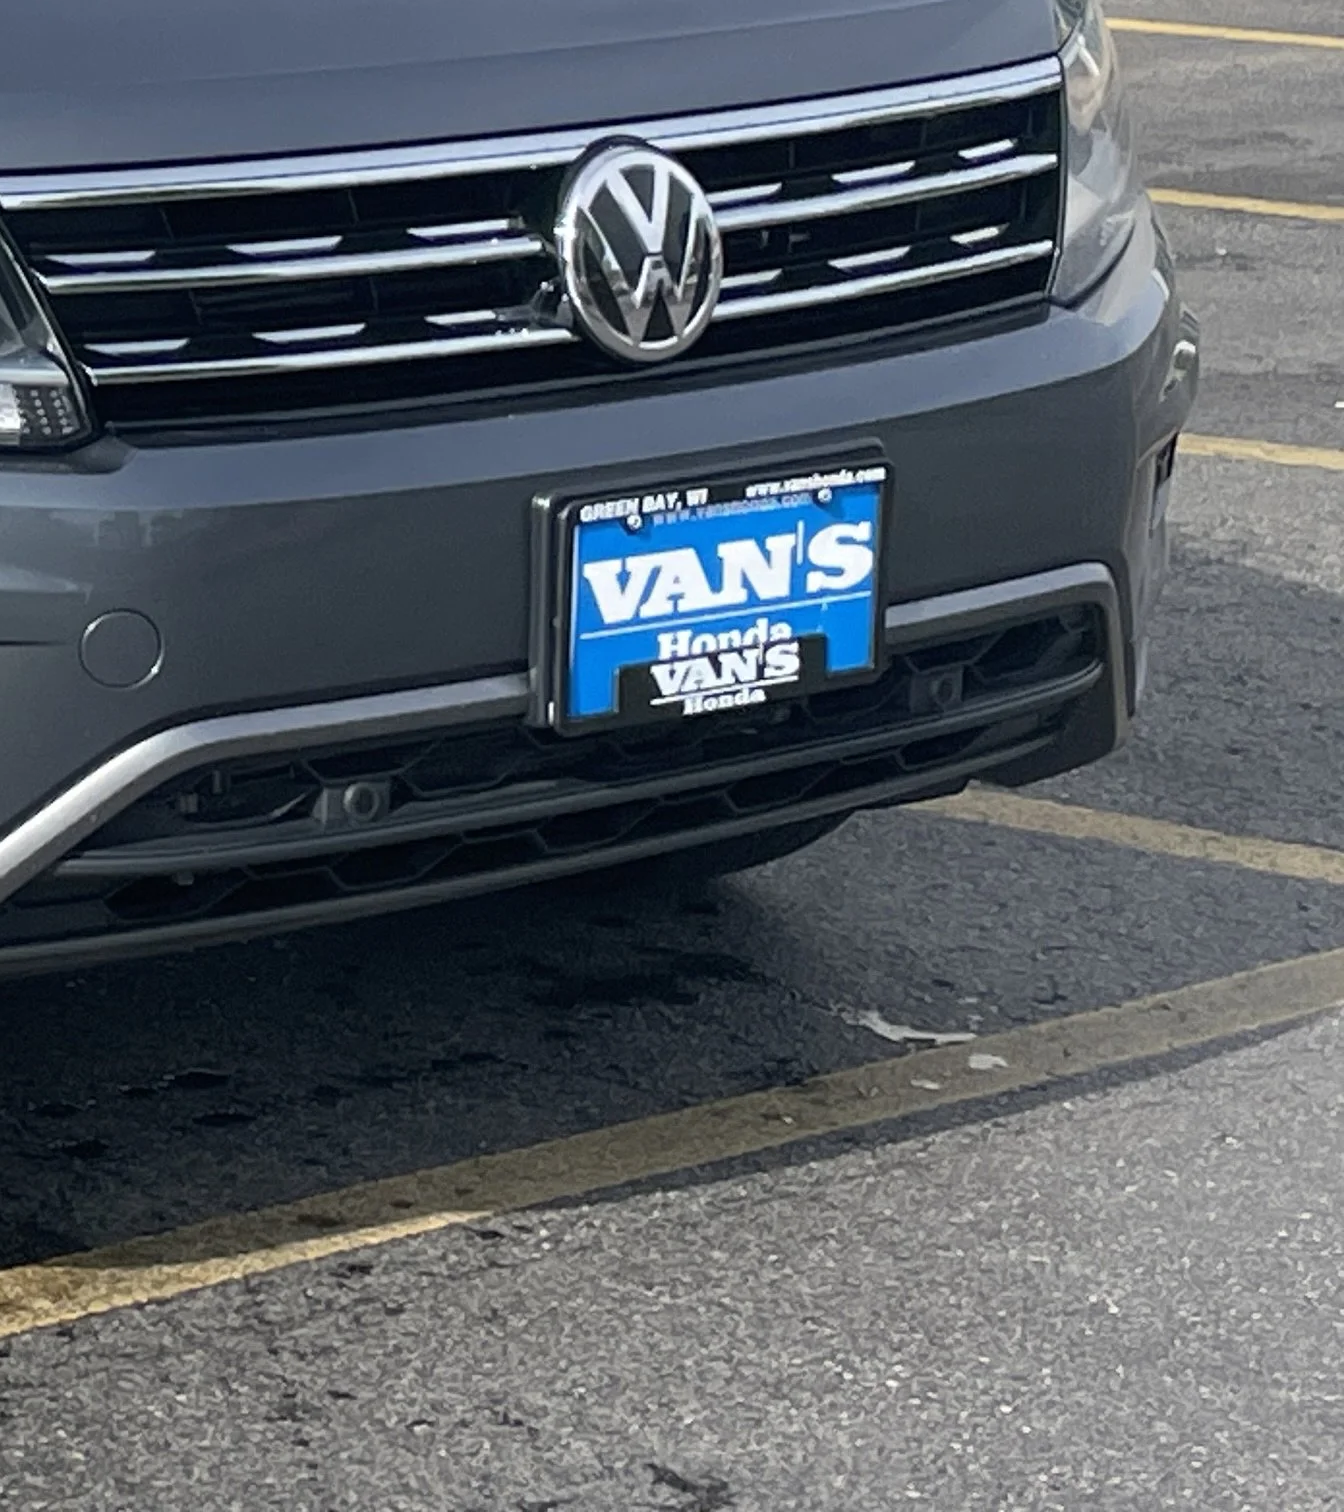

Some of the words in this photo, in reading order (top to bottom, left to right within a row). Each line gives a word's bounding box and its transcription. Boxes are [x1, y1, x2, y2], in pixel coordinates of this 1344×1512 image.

[567, 152, 716, 353] VW
[579, 496, 640, 523] GREEN
[642, 490, 683, 514] BAY,
[583, 520, 874, 625] VAN'S
[656, 618, 793, 661] Honda
[649, 639, 801, 697] VAN'S
[682, 688, 767, 716] Honda
